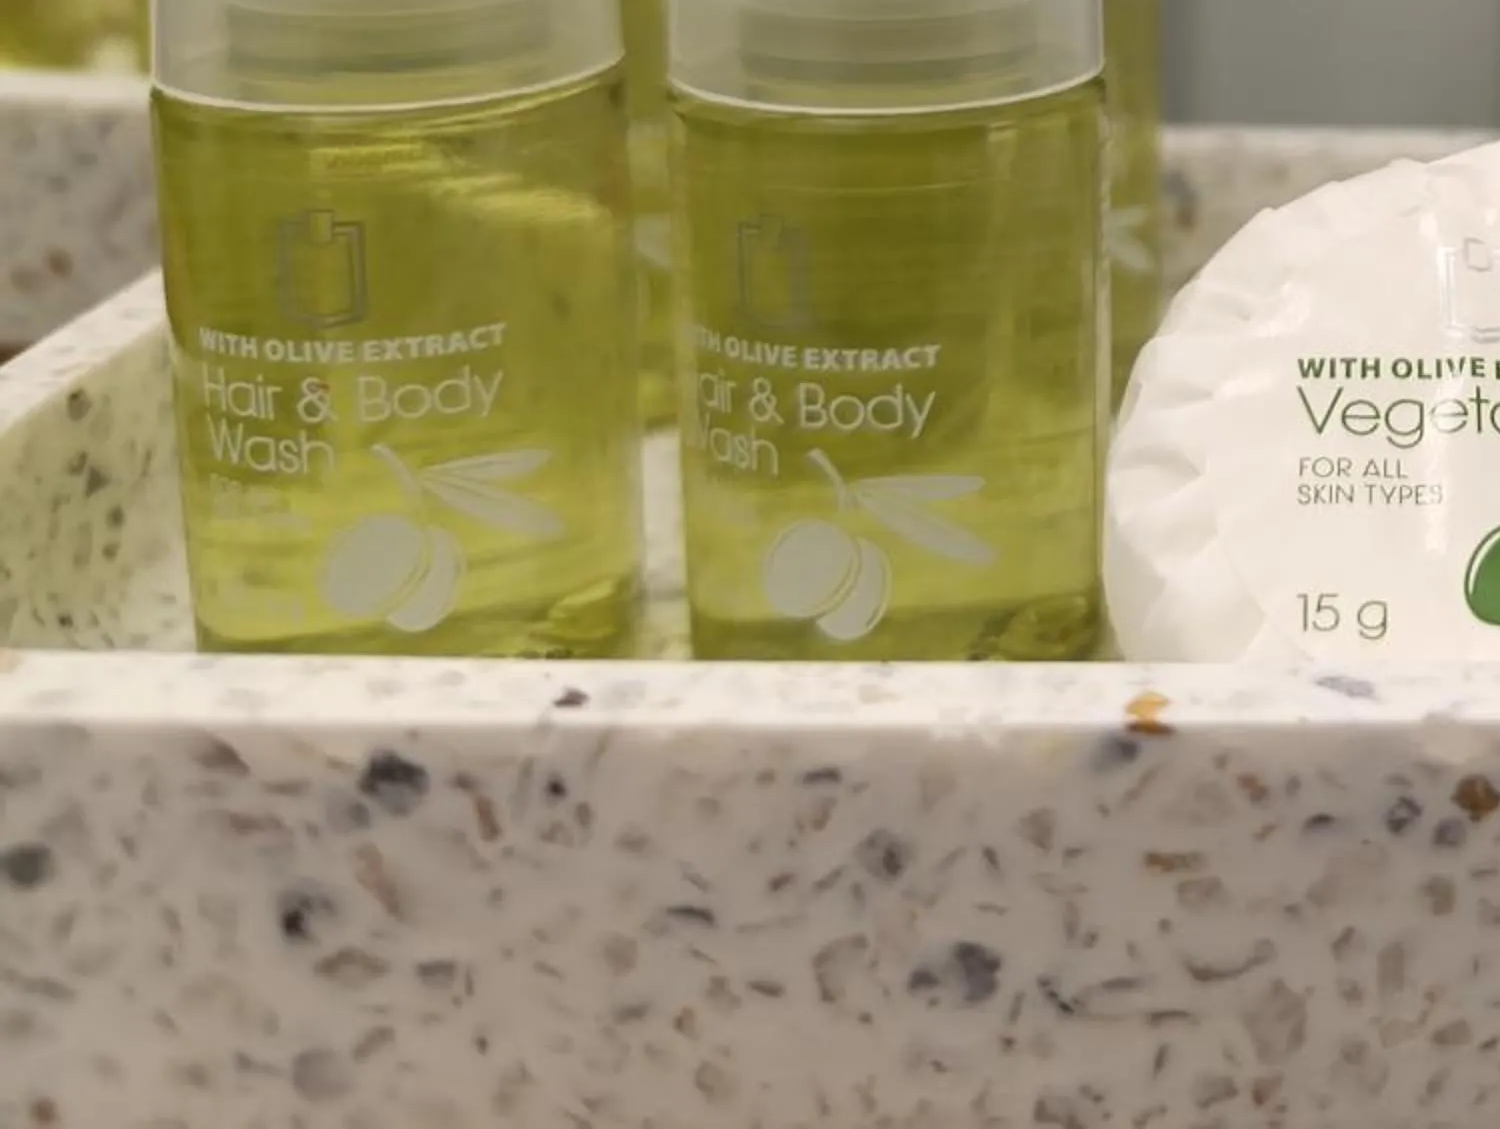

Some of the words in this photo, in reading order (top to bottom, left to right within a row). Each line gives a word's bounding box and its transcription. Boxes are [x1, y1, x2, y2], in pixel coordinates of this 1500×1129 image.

[200, 327, 258, 360] WITH
[263, 338, 355, 363] OLIVE
[363, 323, 507, 362] EXTRACT
[724, 336, 798, 368] OLIVE
[803, 344, 942, 371] EXTRACT
[1297, 357, 1381, 379] WITH
[1391, 356, 1486, 380] OLIVE
[201, 362, 282, 420] Hair
[297, 376, 340, 424] &
[358, 365, 504, 423] Body
[749, 377, 785, 425] &
[800, 380, 936, 439] Body
[206, 412, 335, 475] Wash
[1299, 456, 1352, 478] FOR
[1362, 458, 1408, 479] ALL
[1297, 484, 1354, 506] SKIN
[1365, 484, 1444, 506] TYPES
[1297, 593, 1340, 632] 15
[1357, 598, 1388, 640] g
